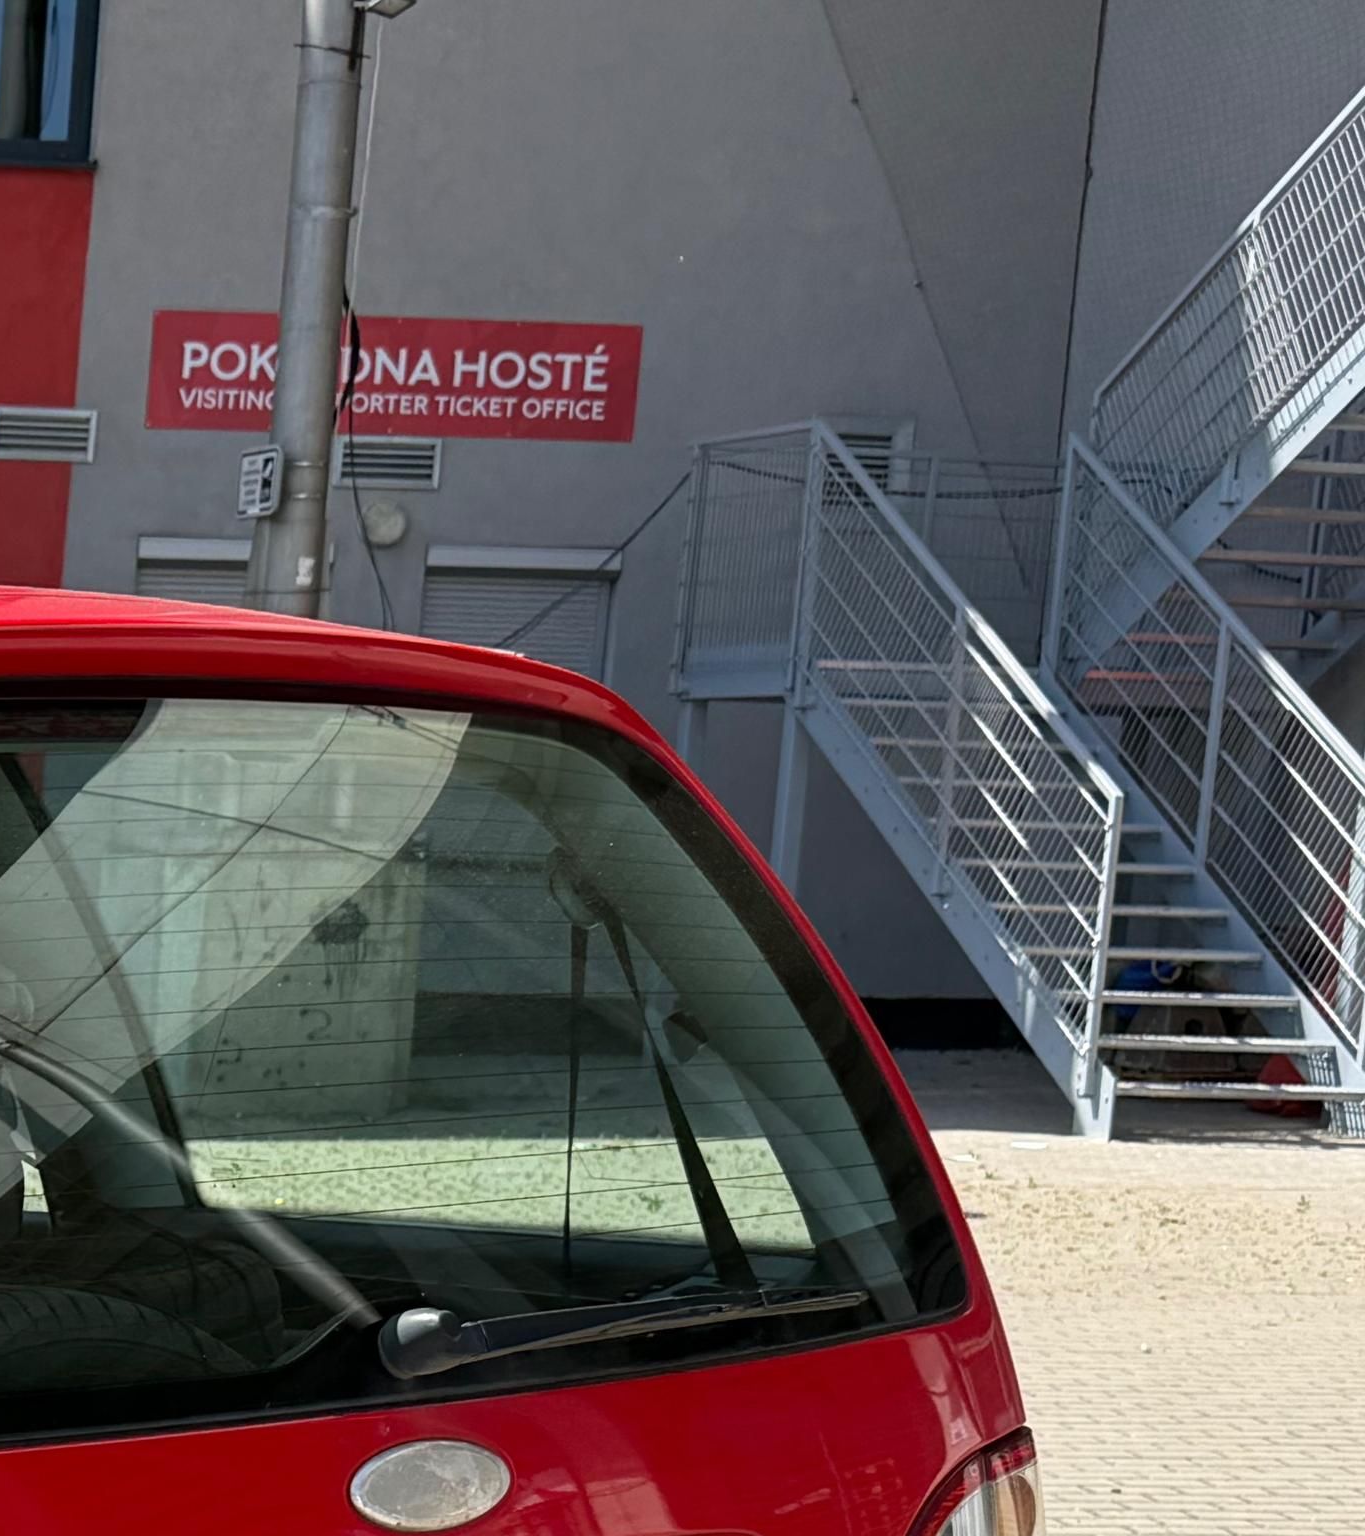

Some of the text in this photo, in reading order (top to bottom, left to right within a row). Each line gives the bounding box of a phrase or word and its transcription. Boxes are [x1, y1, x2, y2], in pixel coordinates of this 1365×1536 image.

[181, 341, 609, 392] POKDNA HOSTÉ
[434, 395, 518, 418] TICKET
[522, 397, 606, 421] OFFICE
